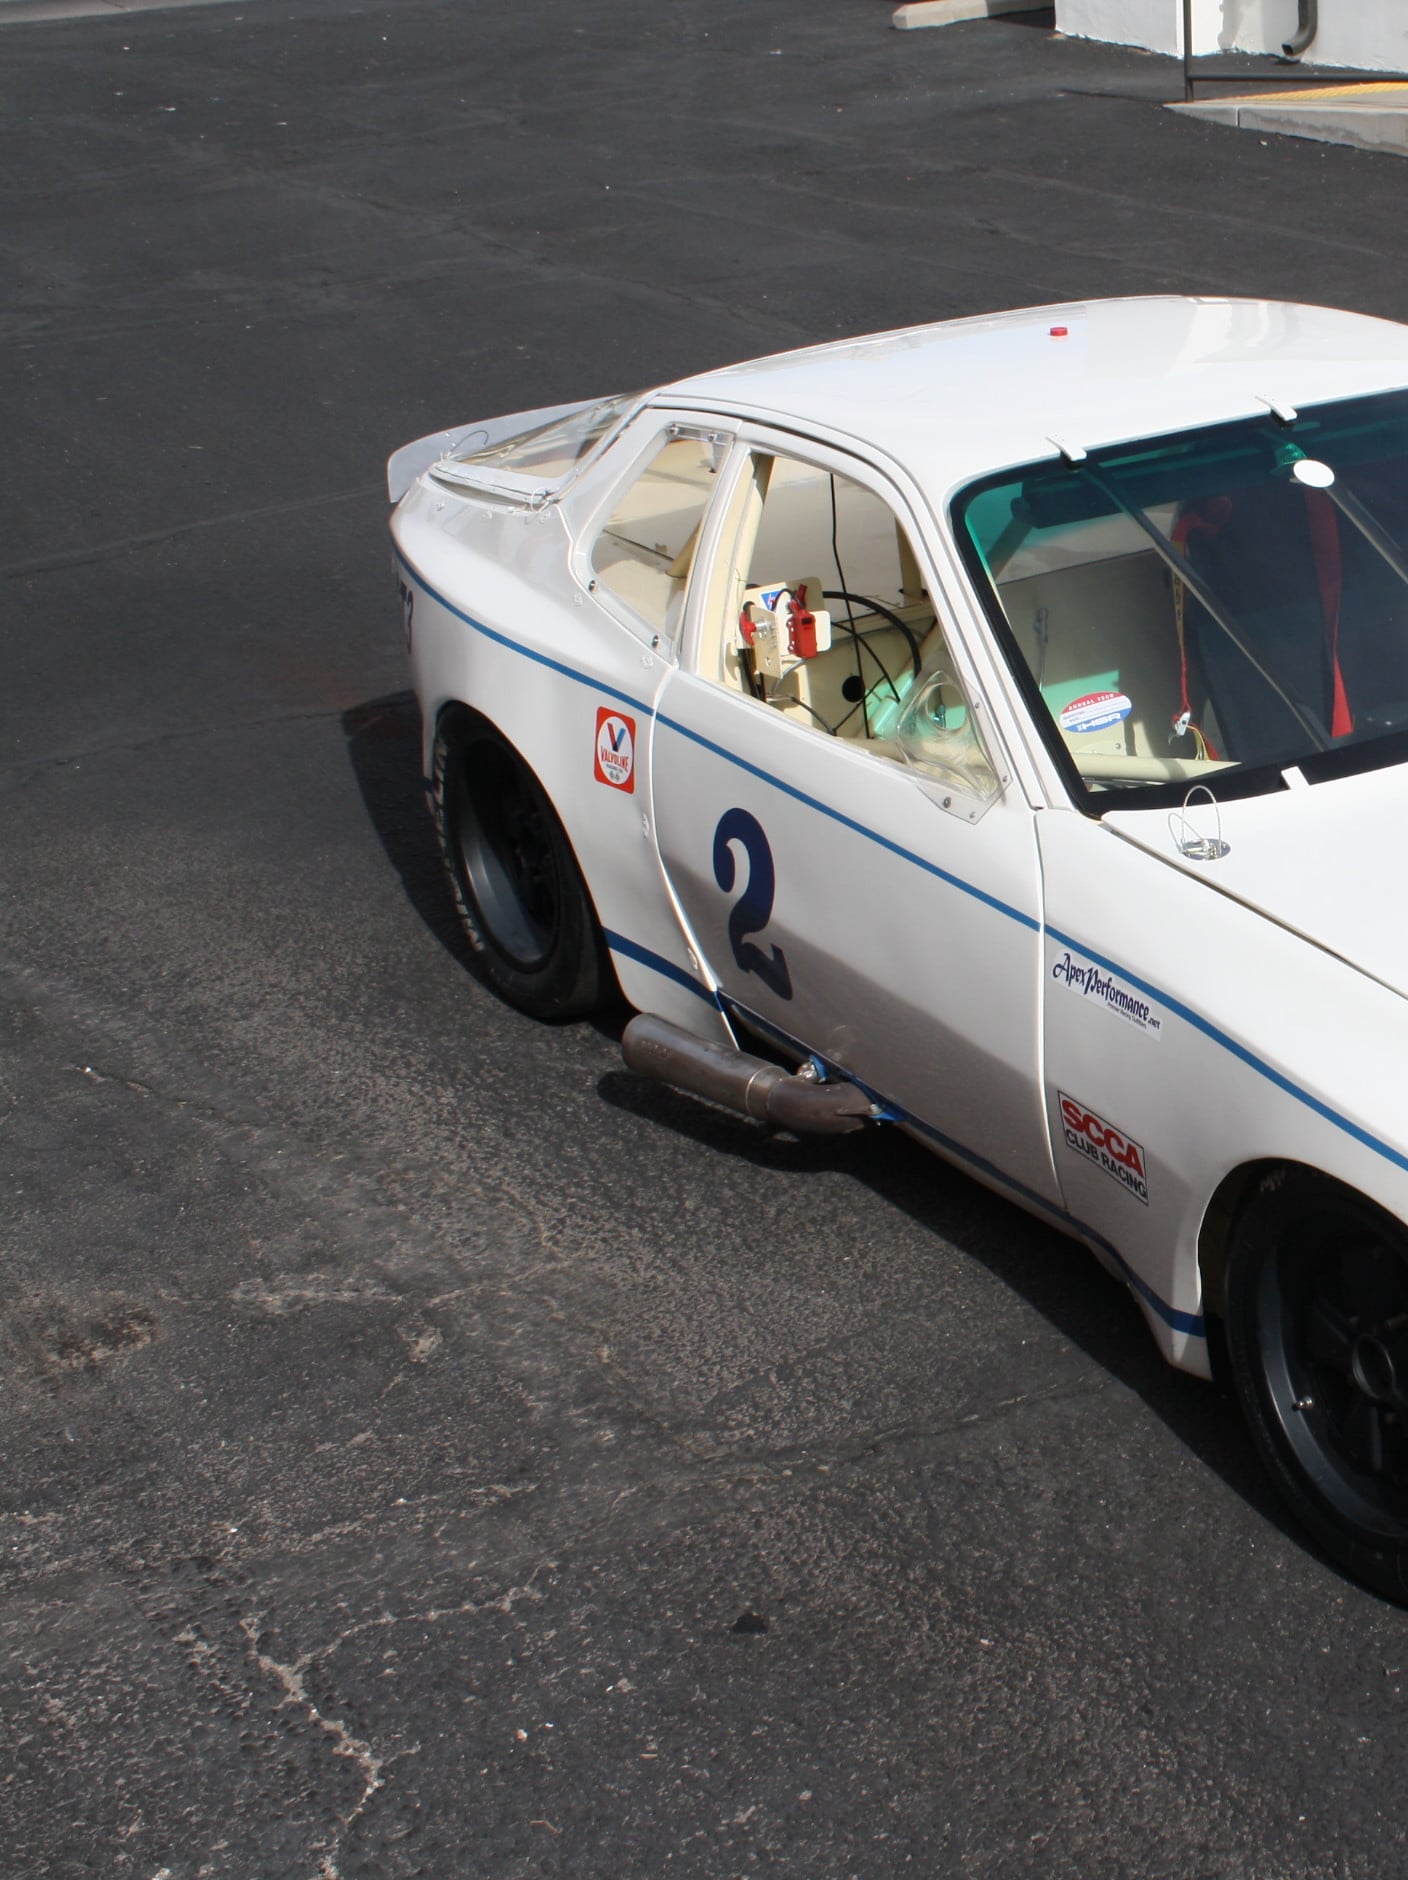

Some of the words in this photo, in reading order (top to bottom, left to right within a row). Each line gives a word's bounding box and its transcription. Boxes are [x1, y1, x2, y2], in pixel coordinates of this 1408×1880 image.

[600, 745, 629, 773] VALVOLINE
[713, 807, 793, 1001] 2
[1061, 1100, 1145, 1178] SCCA
[1065, 1129, 1099, 1160] CLUB
[1101, 1151, 1148, 1198] RACING
